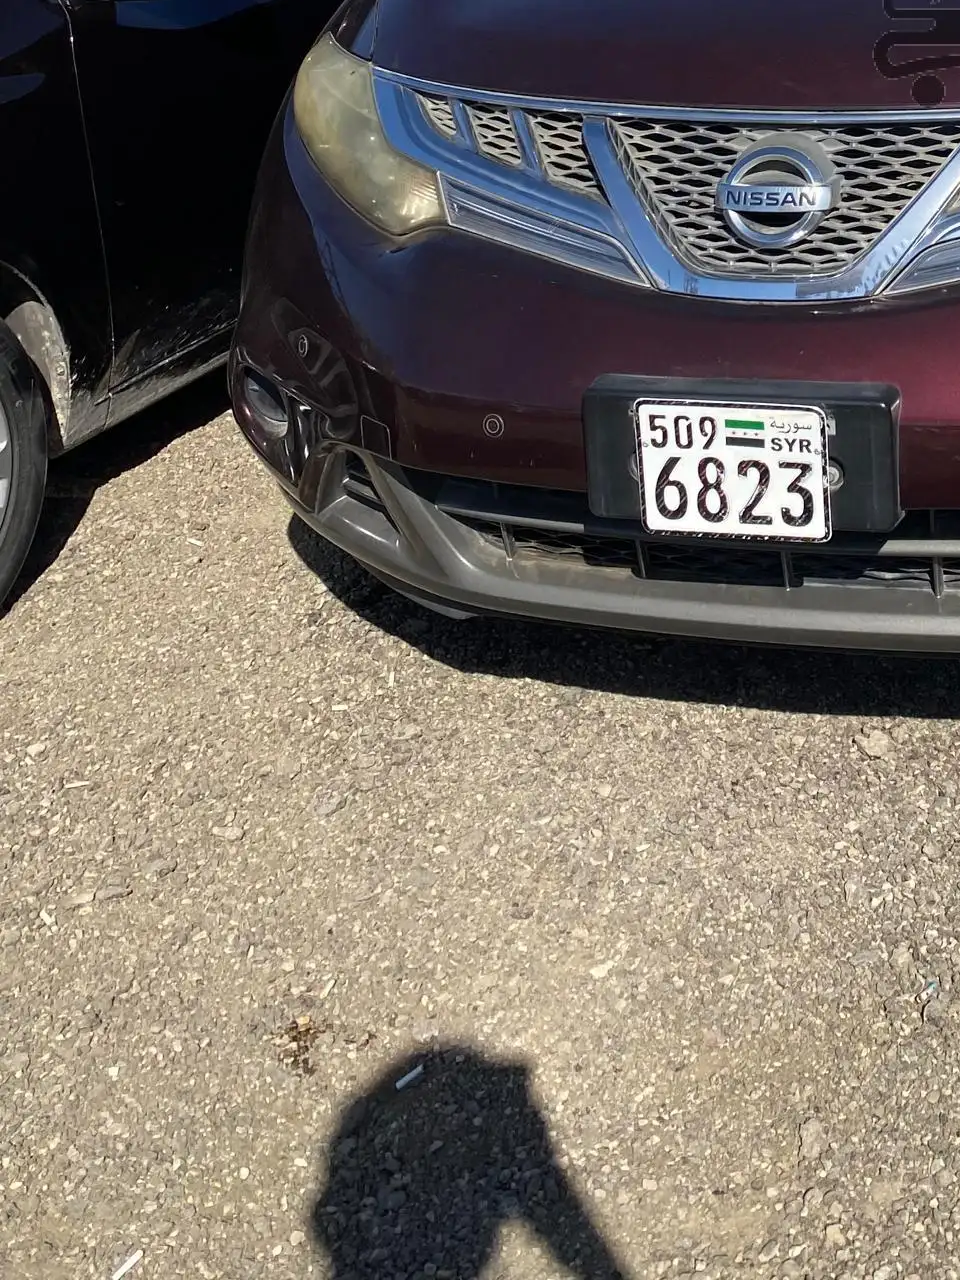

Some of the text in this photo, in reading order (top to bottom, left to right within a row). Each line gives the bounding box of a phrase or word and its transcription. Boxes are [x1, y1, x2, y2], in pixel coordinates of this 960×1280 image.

[726, 190, 817, 207] NISSAN
[648, 414, 717, 450] 509
[769, 416, 813, 434] سورية
[770, 437, 813, 454] SYR
[655, 456, 815, 528] 6823
